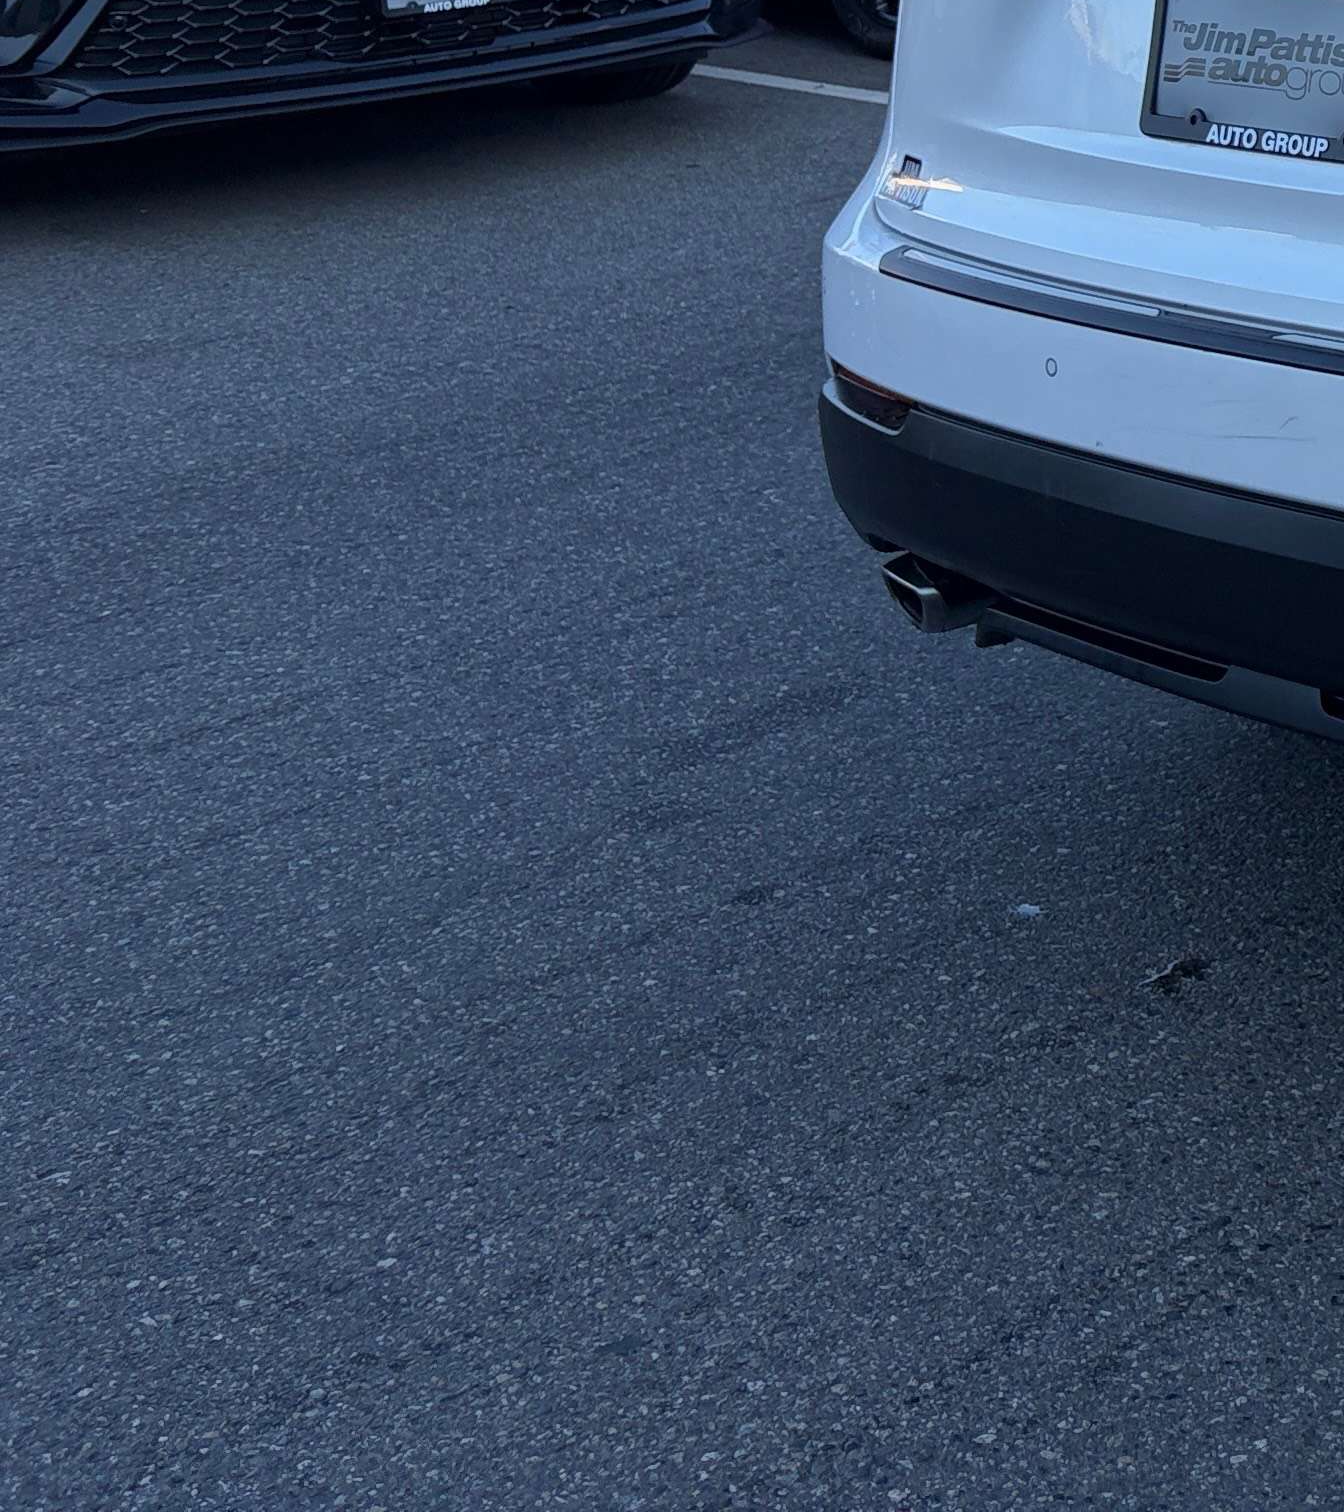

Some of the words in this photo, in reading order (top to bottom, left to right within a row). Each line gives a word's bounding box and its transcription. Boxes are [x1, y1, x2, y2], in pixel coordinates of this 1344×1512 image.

[424, 0, 452, 13] AUTO
[1172, 19, 1198, 34] The
[1206, 123, 1257, 148] AUTO
[1261, 130, 1329, 158] GROUP
